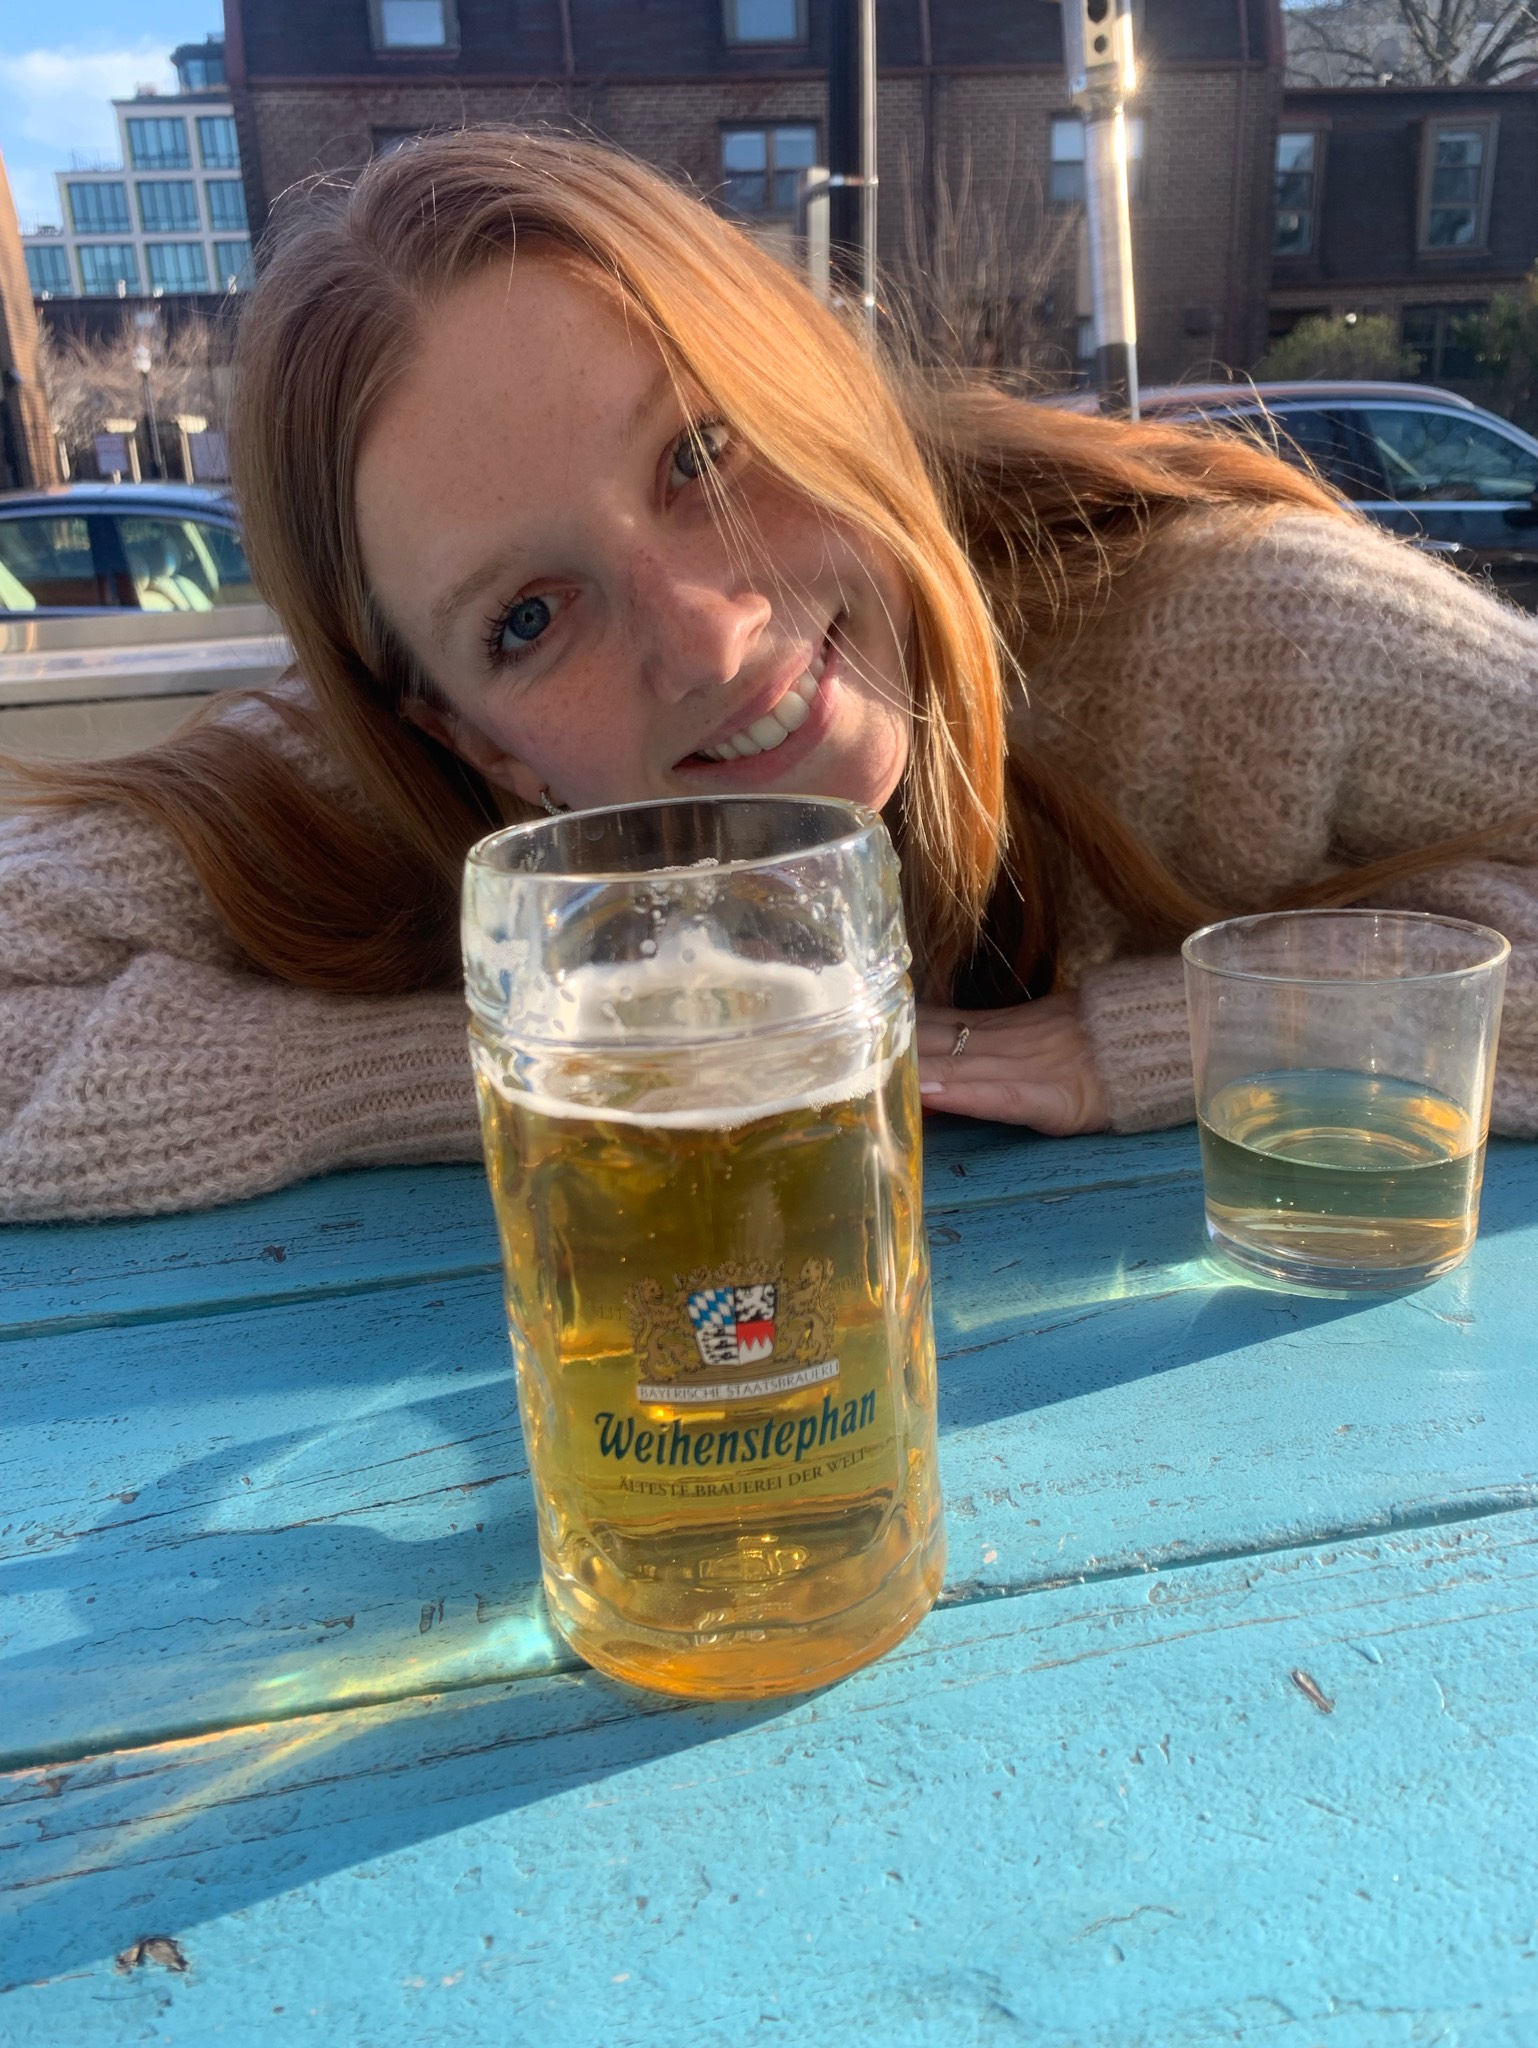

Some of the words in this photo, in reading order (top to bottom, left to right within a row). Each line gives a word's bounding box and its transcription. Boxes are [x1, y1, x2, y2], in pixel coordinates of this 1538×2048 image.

[640, 1384, 720, 1399] BAYERISCHE
[726, 1364, 839, 1397] STAATSBRAUEREI
[594, 1387, 877, 1467] Weihenstephan
[620, 1475, 691, 1497] ÄLTESTE
[696, 1475, 783, 1498] BRAUEREI
[788, 1465, 823, 1486] DER
[825, 1447, 866, 1473] WELT
